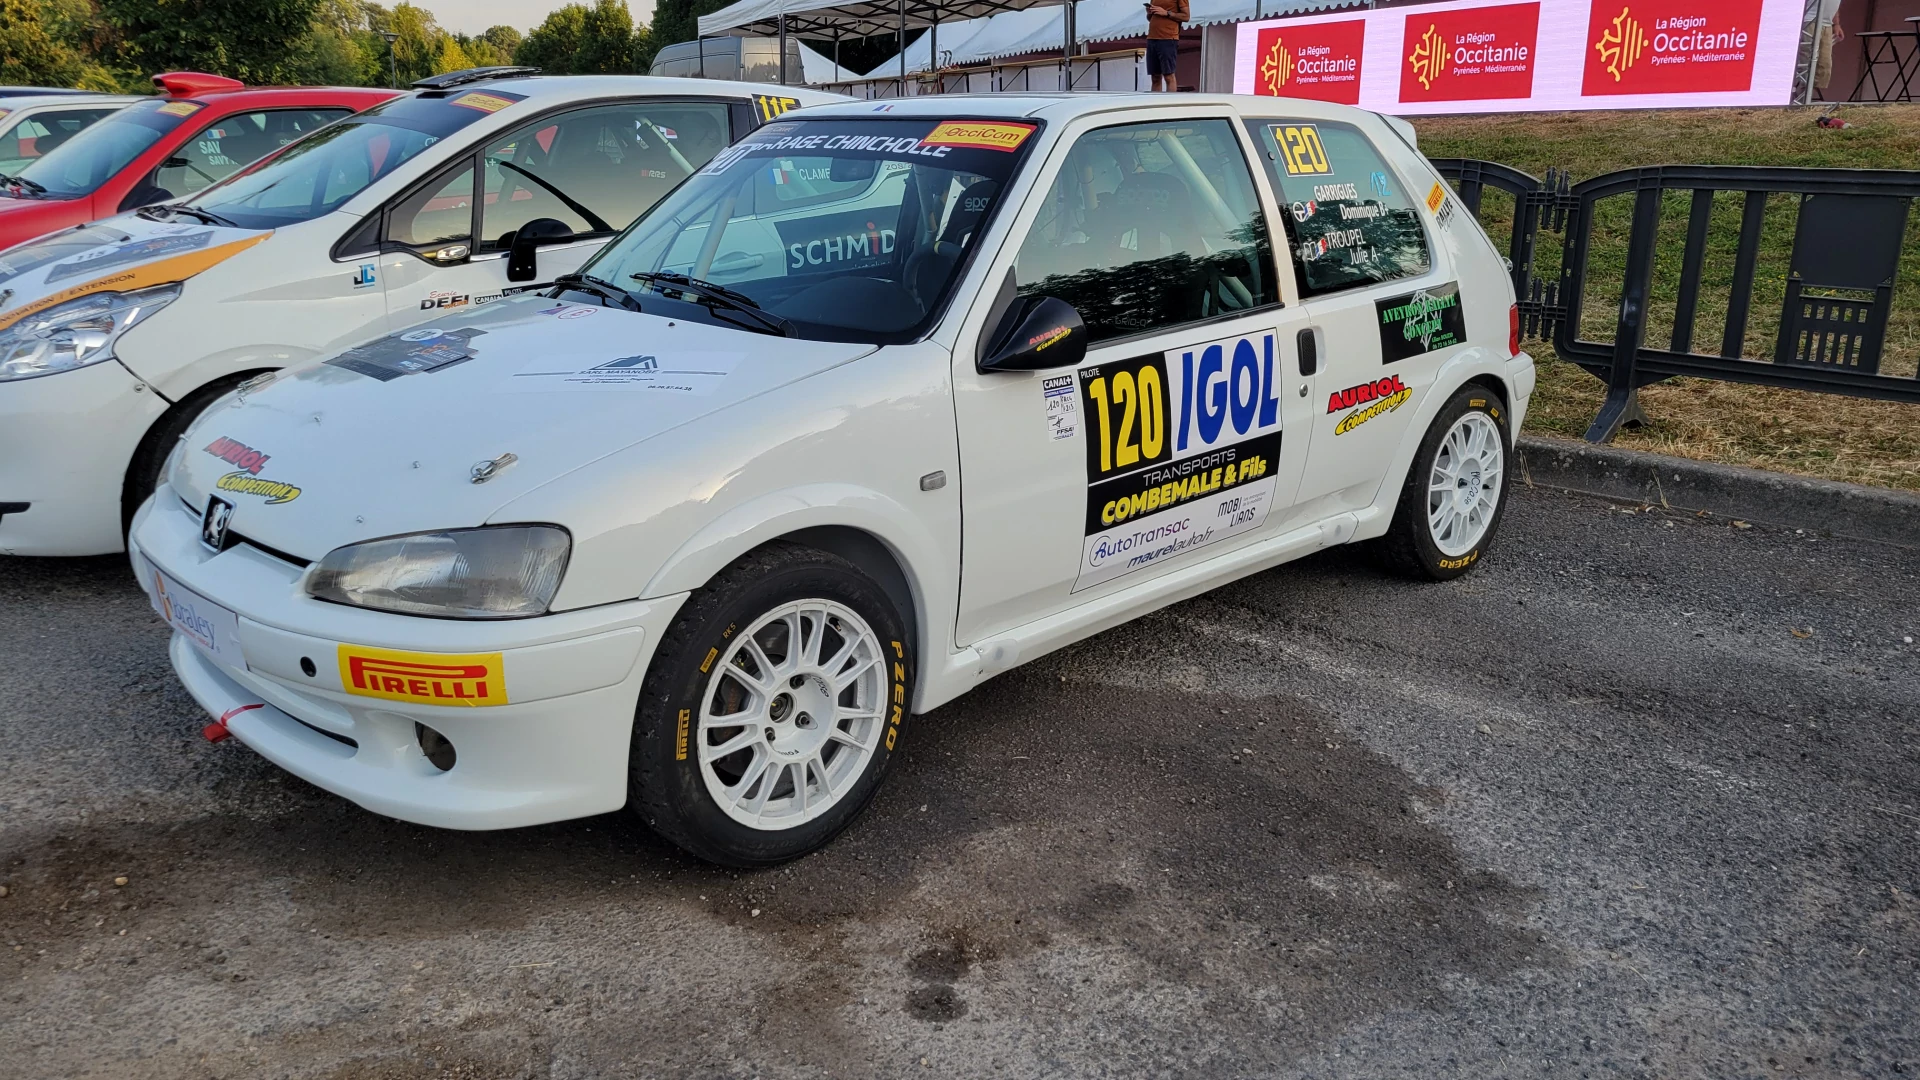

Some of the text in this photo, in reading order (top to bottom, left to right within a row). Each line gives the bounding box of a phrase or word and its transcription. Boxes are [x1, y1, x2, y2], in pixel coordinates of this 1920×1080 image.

[1656, 16, 1707, 31] La Région
[1456, 32, 1495, 46] La Région
[1653, 27, 1748, 53] Occitanie
[1298, 45, 1330, 57] La Région
[1454, 42, 1528, 65] Occitanie
[1651, 54, 1686, 67] Pyrénées
[1692, 51, 1745, 63] Méditerranée
[1297, 55, 1356, 74] Occitanie
[1453, 65, 1480, 77] Pyrénées
[1485, 63, 1526, 73] Méditerranée
[1296, 75, 1318, 84] Pyrénées
[1322, 74, 1355, 83] Méditerranée
[945, 127, 1020, 142] OcciCom
[1275, 127, 1328, 174] 120
[1313, 183, 1358, 202] GARRIGUES
[1339, 201, 1379, 222] Dominique
[1325, 228, 1367, 250] TROUPEL
[1350, 248, 1368, 265] Julie
[68, 273, 136, 296] EXTENSION
[353, 263, 376, 286] JC
[1382, 293, 1456, 324] AVEYRON RALLYE
[1029, 325, 1068, 345] AURIOL
[1403, 318, 1444, 341] CONCEPT
[1043, 375, 1072, 390] CANAL+
[1080, 368, 1100, 379] PILOTE
[1176, 334, 1279, 453] IGOL
[1326, 374, 1405, 415] AURIOL
[1088, 365, 1164, 472] 120
[1337, 388, 1411, 434] COMPETITION
[202, 435, 272, 476] AURIOL
[1143, 449, 1236, 487] TRANSPORTS
[217, 473, 301, 502] COMPETITION
[1101, 455, 1267, 526] COMBEMALE & Fils
[1091, 517, 1190, 563] AutoTransac
[168, 592, 215, 650] braley
[348, 655, 488, 699] PIRELLI
[675, 708, 691, 761] PIRELLI
